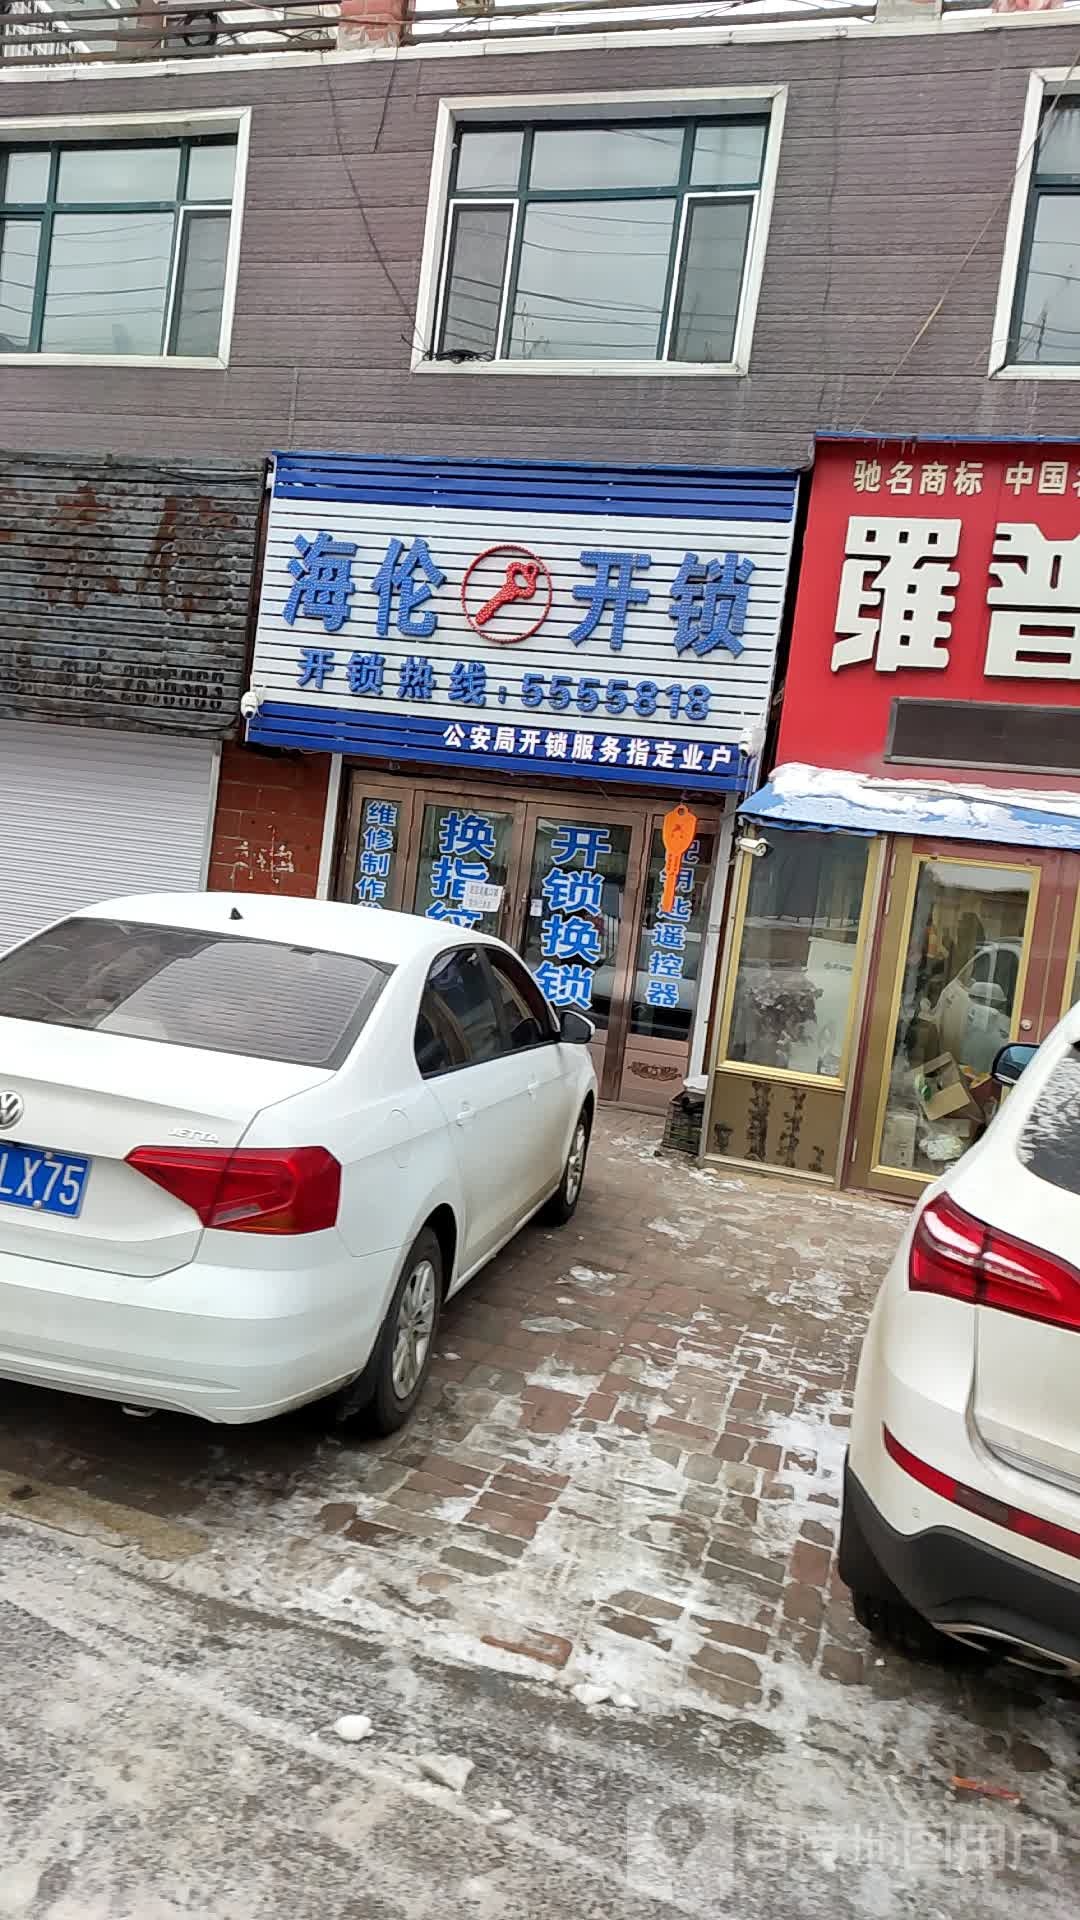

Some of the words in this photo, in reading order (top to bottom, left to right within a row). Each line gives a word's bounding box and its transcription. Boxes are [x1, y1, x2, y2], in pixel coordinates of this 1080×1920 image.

[853, 459, 985, 497] 驰名商标
[1004, 460, 1080, 499] 中国
[282, 531, 448, 637] 海伦
[567, 550, 757, 660] 开锁
[443, 722, 733, 773] 公安局开锁服务指定业户
[354, 800, 398, 909] 维修制作
[533, 824, 612, 1011] 开锁换锁
